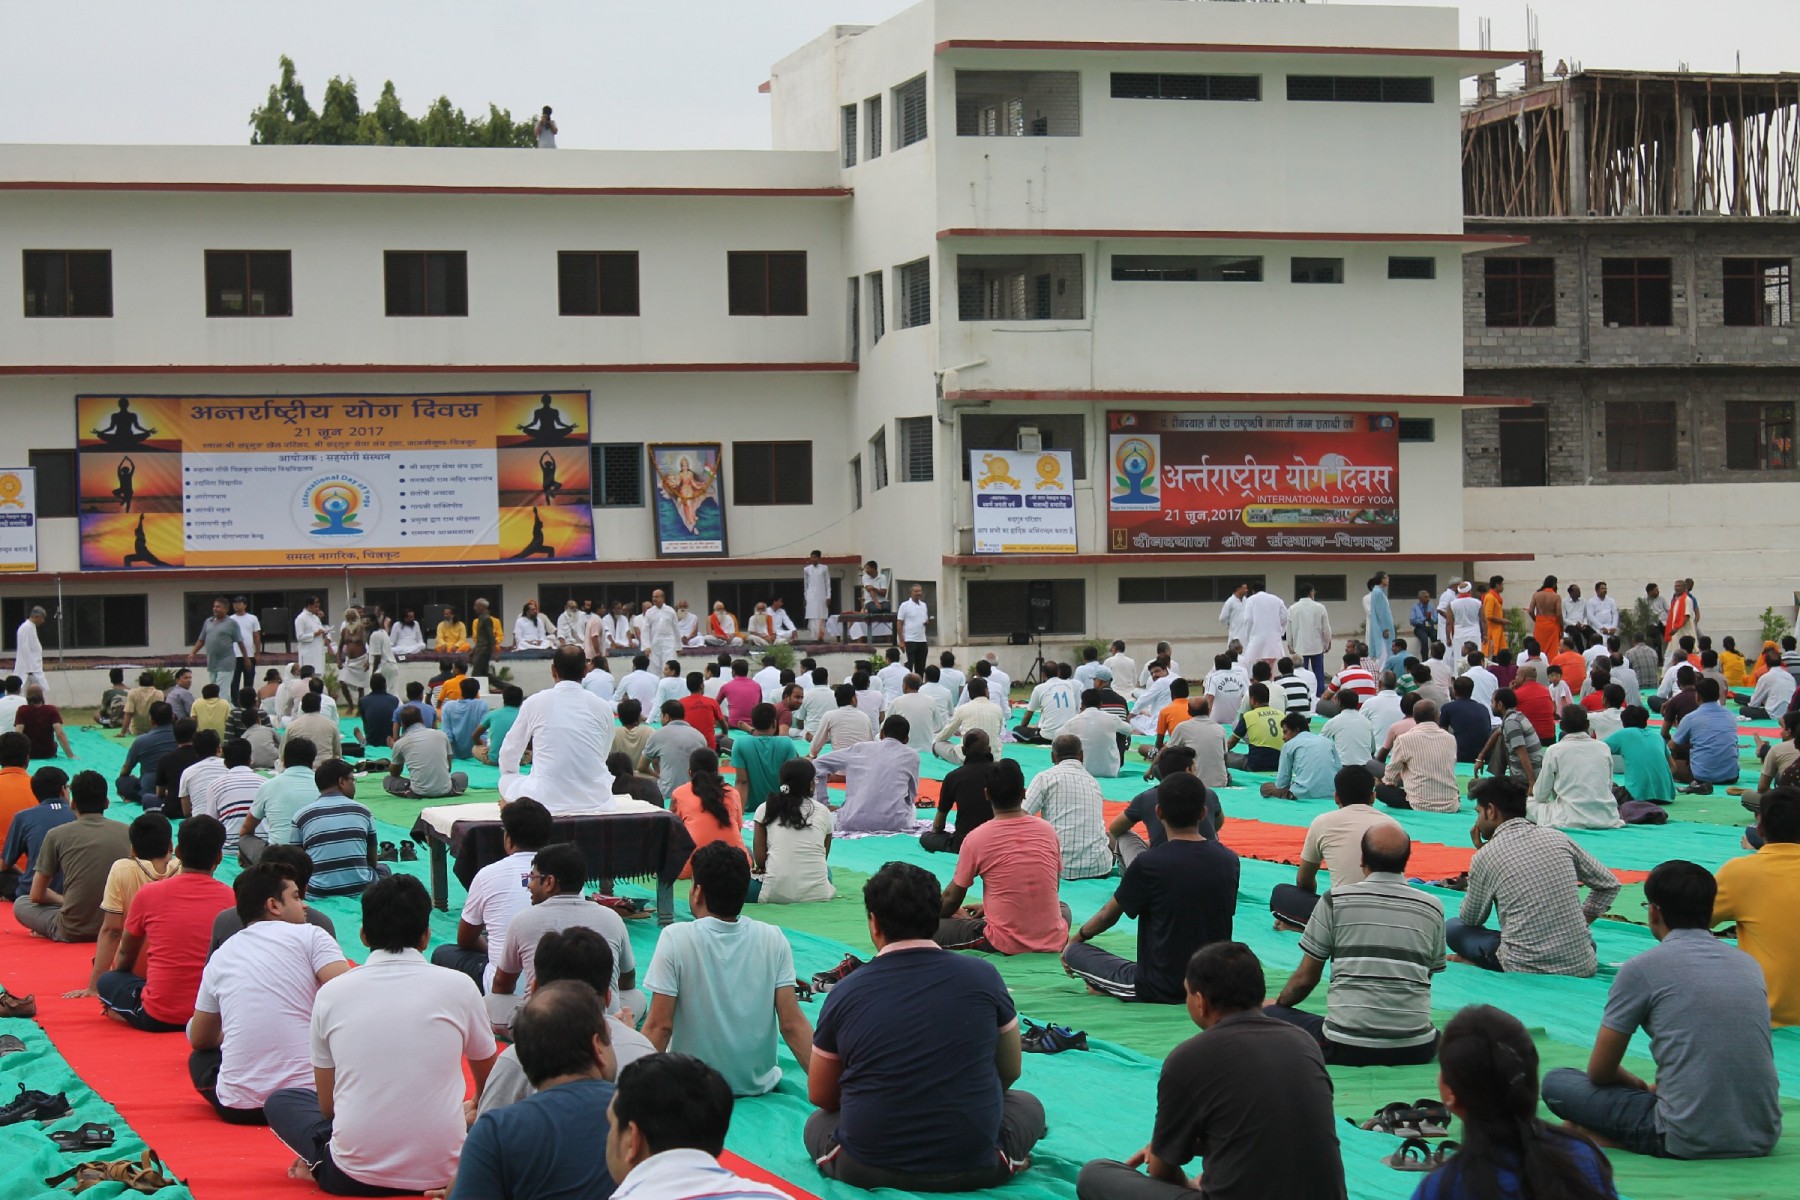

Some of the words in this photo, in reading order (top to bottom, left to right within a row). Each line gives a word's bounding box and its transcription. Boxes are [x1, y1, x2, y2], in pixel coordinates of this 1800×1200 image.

[190, 400, 334, 424] अन्तर्राष्ट्रीय
[342, 400, 402, 419] योग
[411, 400, 482, 419] दिवस
[1206, 415, 1216, 428] जी
[1220, 416, 1230, 429] एवं
[1266, 416, 1293, 428] नानाजी
[294, 428, 310, 437] 21
[317, 428, 342, 440] जून
[349, 426, 384, 436] 2017
[279, 452, 317, 462] आयोजक
[326, 452, 360, 462] सहयोगी
[362, 452, 392, 461] संस्थान
[1286, 455, 1330, 492] योग
[1335, 454, 1394, 494] दिवस
[302, 474, 339, 508] International
[342, 475, 358, 486] Day
[363, 489, 371, 508] Yoga
[1257, 496, 1330, 504] INTERNATIONAL
[1332, 496, 1350, 504] DAY
[1352, 496, 1364, 504] OF
[1368, 496, 1394, 504] YOGA
[1165, 510, 1180, 521] 21
[1132, 532, 1211, 548] दीनदयाल
[1222, 531, 1257, 548] शोध
[286, 553, 315, 561] समस्त
[1053, 691, 1069, 708] 11
[1268, 718, 1278, 737] 8
